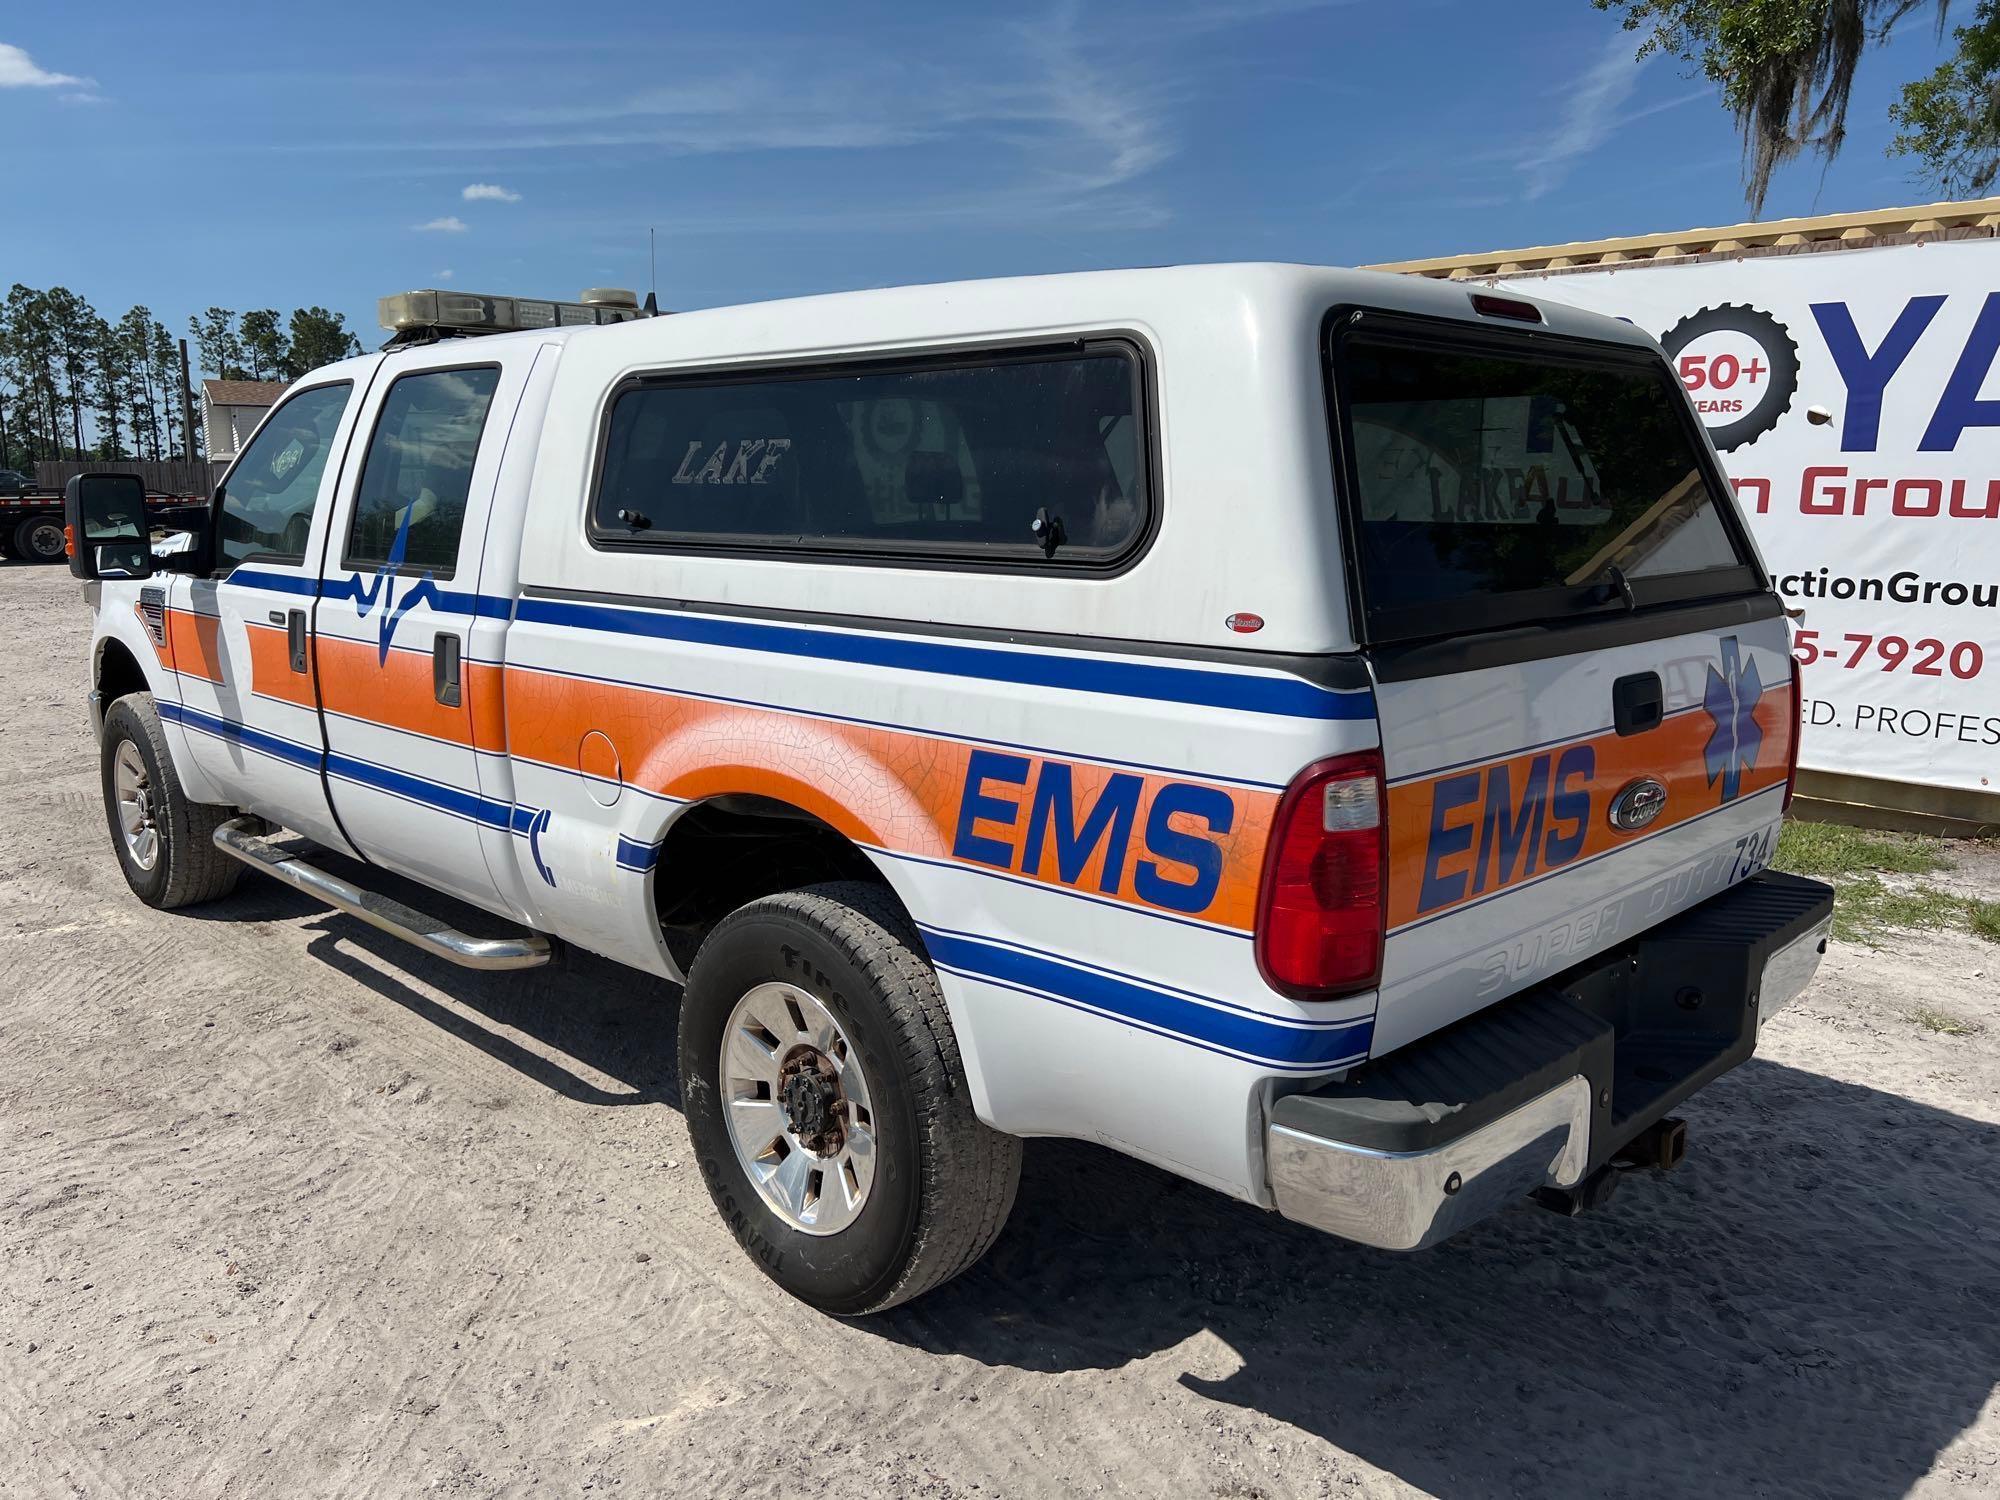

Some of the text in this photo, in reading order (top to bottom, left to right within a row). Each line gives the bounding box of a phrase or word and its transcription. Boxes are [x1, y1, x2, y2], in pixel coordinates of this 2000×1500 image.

[1680, 354, 1767, 391] 50+
[1800, 467, 2000, 518] Grou
[1793, 630, 1984, 680] 5-7920
[1802, 699, 2000, 745] D. PROFES
[952, 749, 1235, 914] EMS
[1417, 745, 1596, 914] EMS
[1630, 790, 1661, 823] Ford
[1728, 825, 1772, 885] 734
[1477, 900, 1625, 997] SUPER
